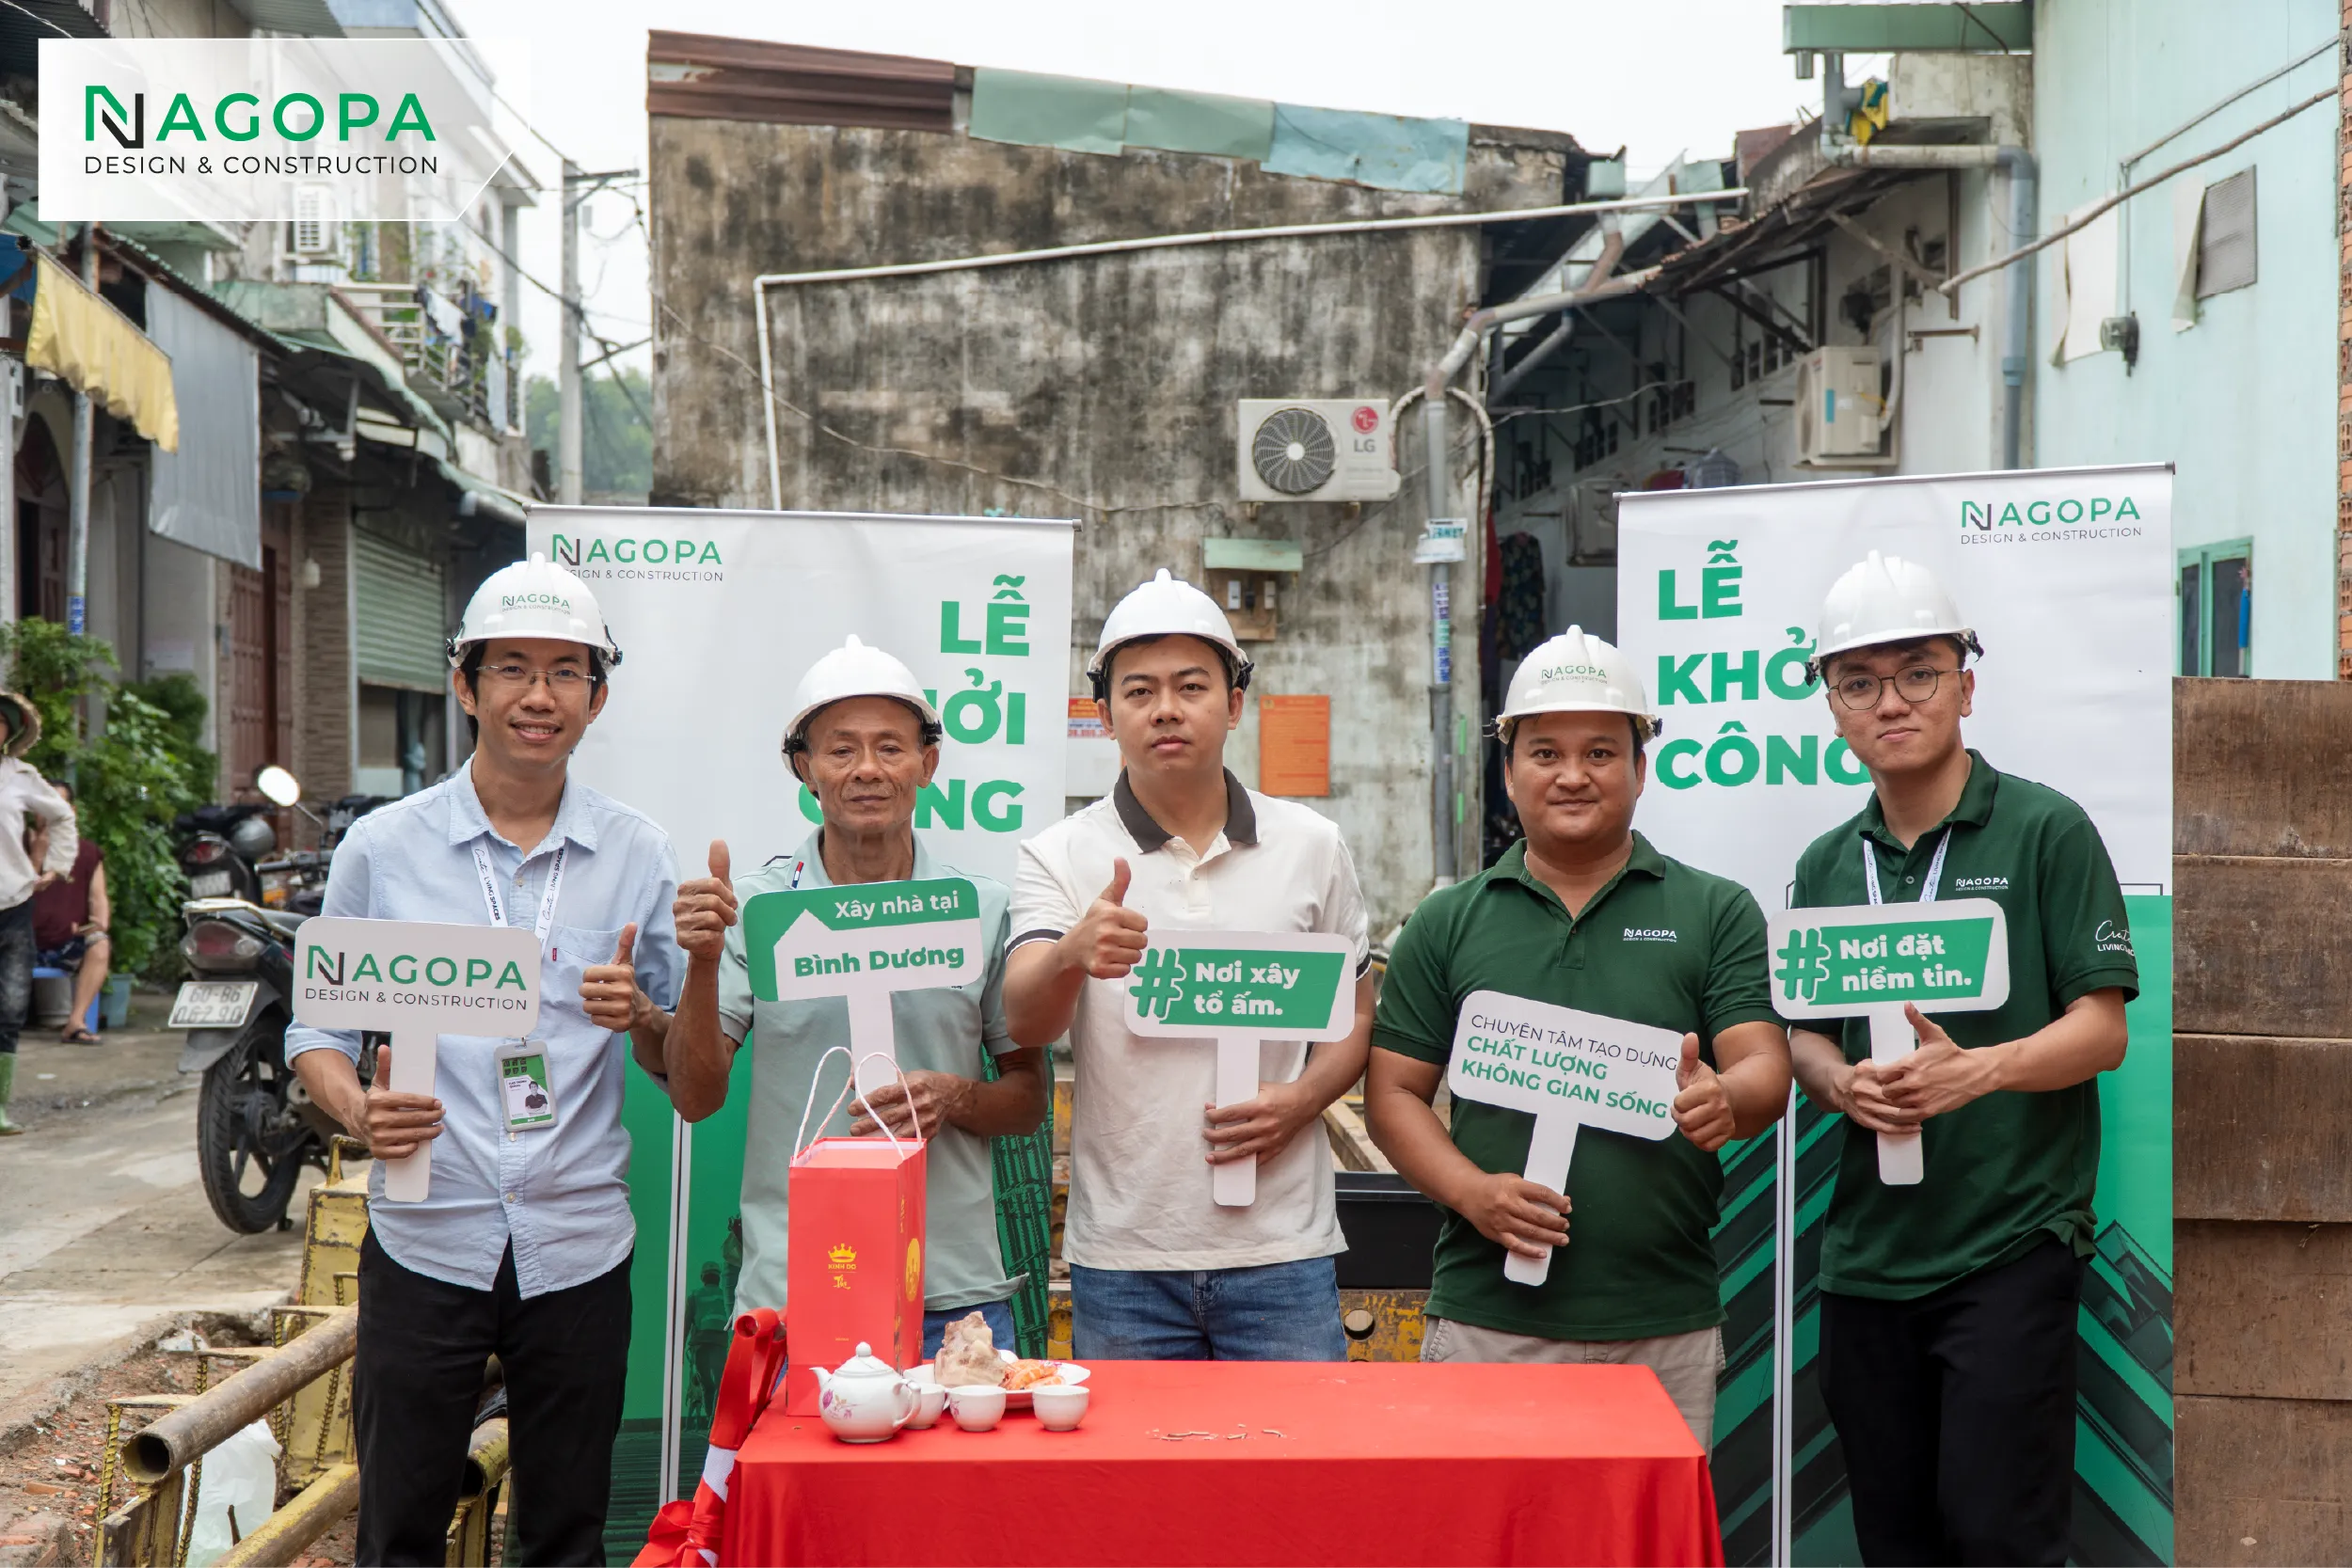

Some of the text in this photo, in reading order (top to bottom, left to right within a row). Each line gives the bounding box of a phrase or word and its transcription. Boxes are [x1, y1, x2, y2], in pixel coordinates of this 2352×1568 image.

[1354, 438, 1376, 453] LG
[1962, 496, 2141, 531] NAGOPA
[551, 533, 723, 566] NAGOPA
[1961, 527, 2142, 545] DESIGN & CONSTRUCTION
[564, 569, 723, 581] SIGN & CONSTRUCTION
[1658, 539, 1743, 621] LỄ
[501, 594, 570, 610] NAGOPA
[940, 574, 1030, 657] LỄ
[1541, 665, 1607, 679] NAGOPA
[1658, 626, 1822, 705] KHỞ
[922, 667, 1026, 745] ỞI
[484, 875, 495, 896] LVING
[1955, 877, 2009, 887] NAGOPA
[834, 890, 960, 921] Xây nhà tại
[1623, 927, 1677, 939] NAGOPA
[2095, 918, 2131, 942] Creat
[1839, 933, 1947, 961] Nơi đặt
[307, 944, 527, 991] NAGOPA
[794, 946, 965, 978] Bình Dương
[1195, 959, 1301, 990] Nơi xây
[1842, 963, 1973, 991] niềm tin.
[305, 988, 528, 1010] DESIGN & CONSTRUCTION
[1193, 990, 1284, 1016] tổ ấm.
[1471, 1014, 1678, 1071] CHUYÊN TÂM TẠO DỰNG
[1467, 1035, 1609, 1081] CHẤT LƯỢNG
[1462, 1058, 1668, 1118] KHÔNG GIAN SỐNG
